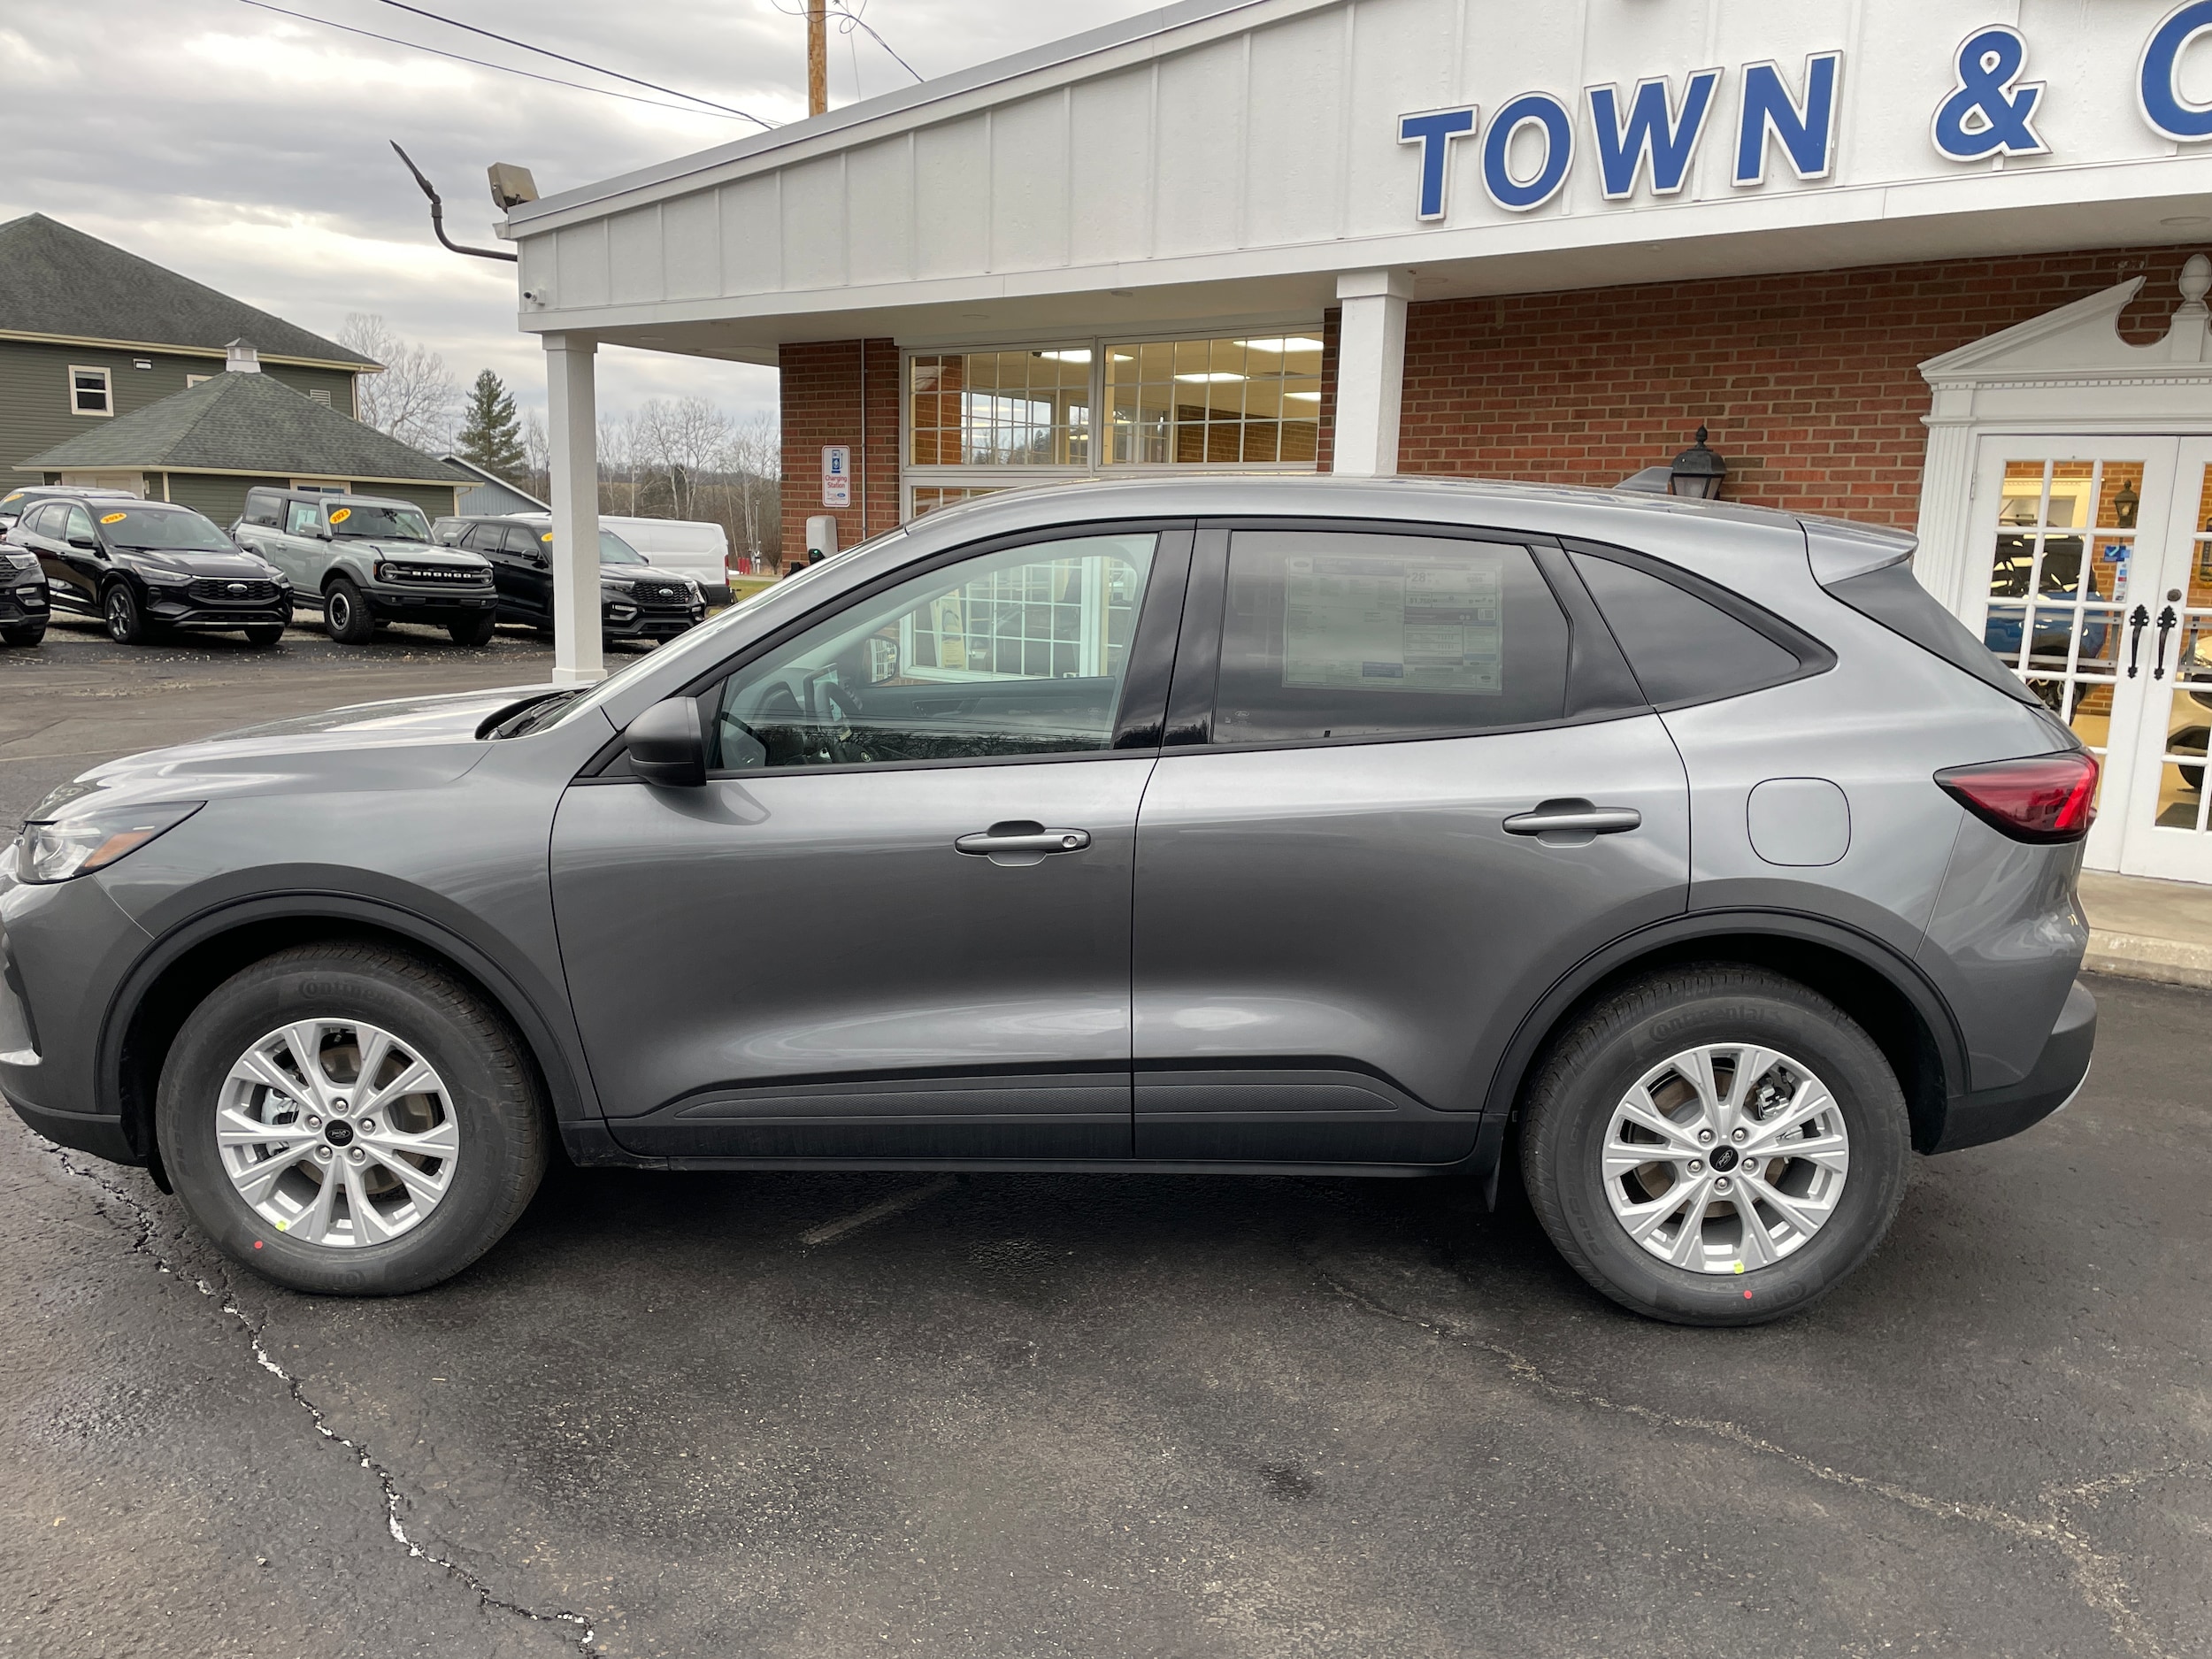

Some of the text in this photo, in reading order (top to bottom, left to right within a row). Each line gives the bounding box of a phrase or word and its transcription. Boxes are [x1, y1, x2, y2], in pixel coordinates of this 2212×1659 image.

[1398, 50, 1843, 220] TOWN
[1931, 24, 2053, 163] &
[331, 509, 349, 523] 2023
[1411, 572, 1426, 582] 28
